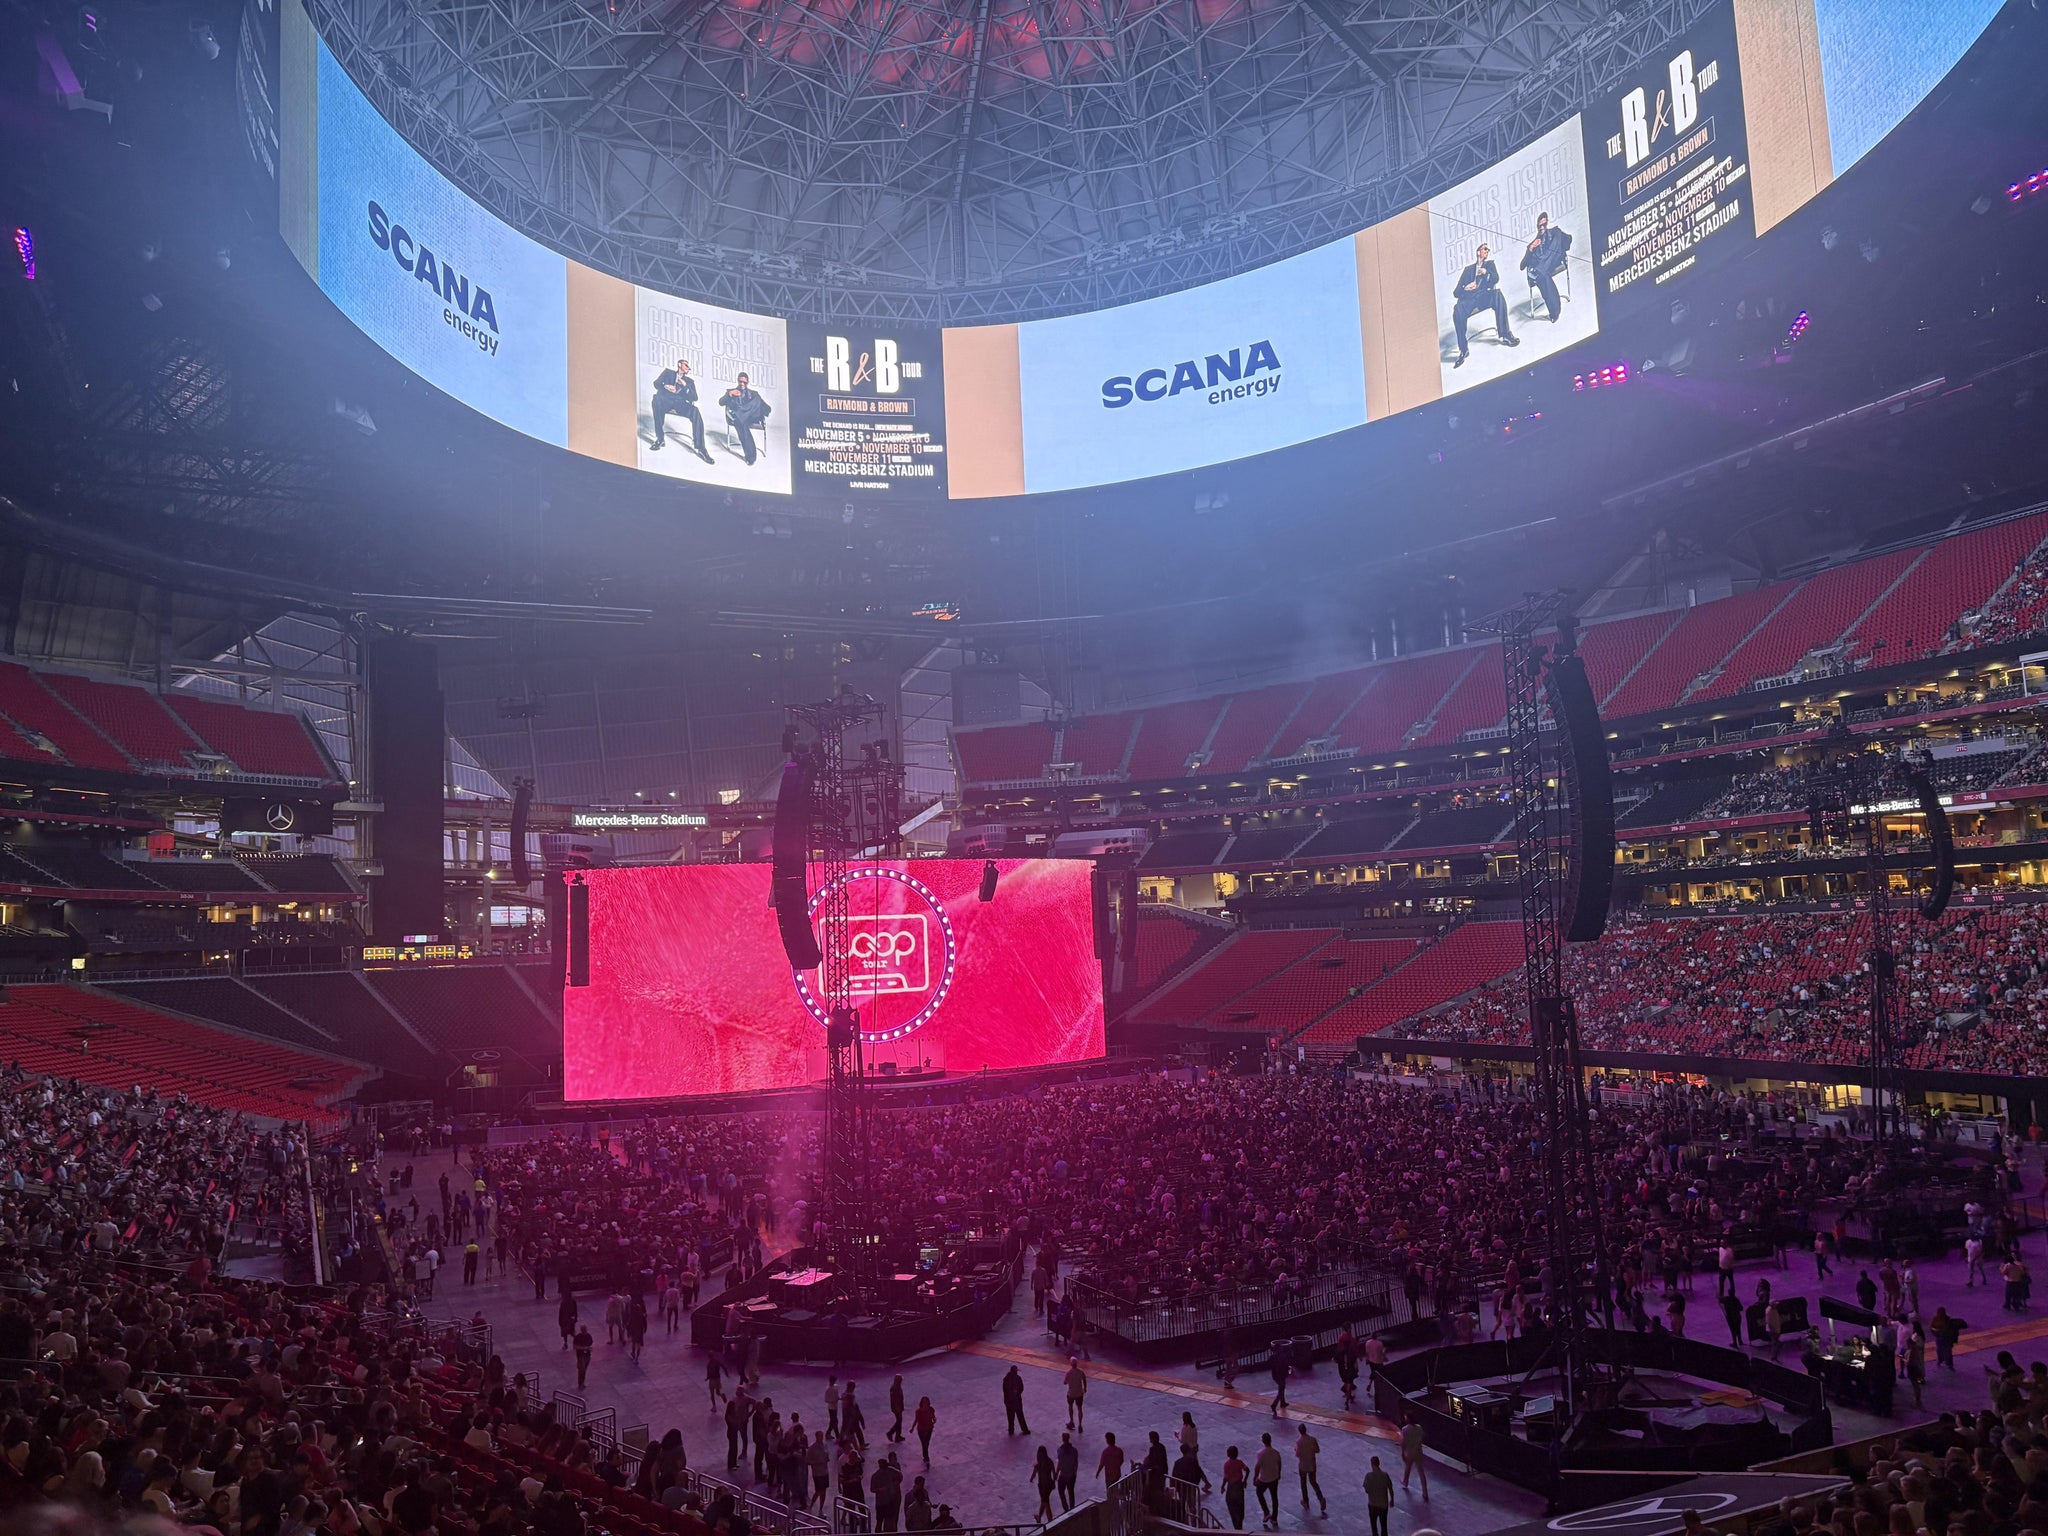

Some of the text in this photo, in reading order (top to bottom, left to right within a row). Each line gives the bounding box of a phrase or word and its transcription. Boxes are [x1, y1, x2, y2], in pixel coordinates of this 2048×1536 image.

[1607, 133, 1621, 158] THE
[1697, 60, 1718, 93] TOUR
[1507, 140, 1575, 213] USHER
[1626, 157, 1668, 195] RAYMOND
[1677, 127, 1708, 161] BROWN
[1443, 184, 1501, 244] CHRIS
[1608, 206, 1658, 248] NOVEMBER
[1660, 202, 1667, 216] 5
[1665, 191, 1713, 228] NOVEMBER
[1715, 177, 1725, 194] 10
[1609, 199, 1739, 293] MERCEDES-BENZ STADIUM
[1633, 213, 1696, 262] NOVEMBER 11
[368, 200, 500, 335] SCANA
[1670, 255, 1696, 276] NATION
[443, 308, 499, 357] energy
[647, 305, 703, 350] CHRIS
[711, 320, 777, 365] USHER
[810, 357, 824, 373] THE
[901, 362, 922, 378] TOUR
[1101, 339, 1281, 409] SCANA
[1208, 374, 1281, 405] energy
[826, 398, 868, 412] RAYMOND
[878, 401, 908, 413] BROWN
[806, 428, 856, 441] NOVEMBER
[858, 432, 864, 442] 5
[829, 451, 879, 464] NOVEMBER
[882, 455, 891, 464] 11
[862, 442, 909, 454] NOVEMBER
[913, 444, 922, 454] 10
[805, 460, 934, 477] MERCEDES-BENZ STADIUM
[575, 814, 706, 826] Mercedes-Benz Stadium
